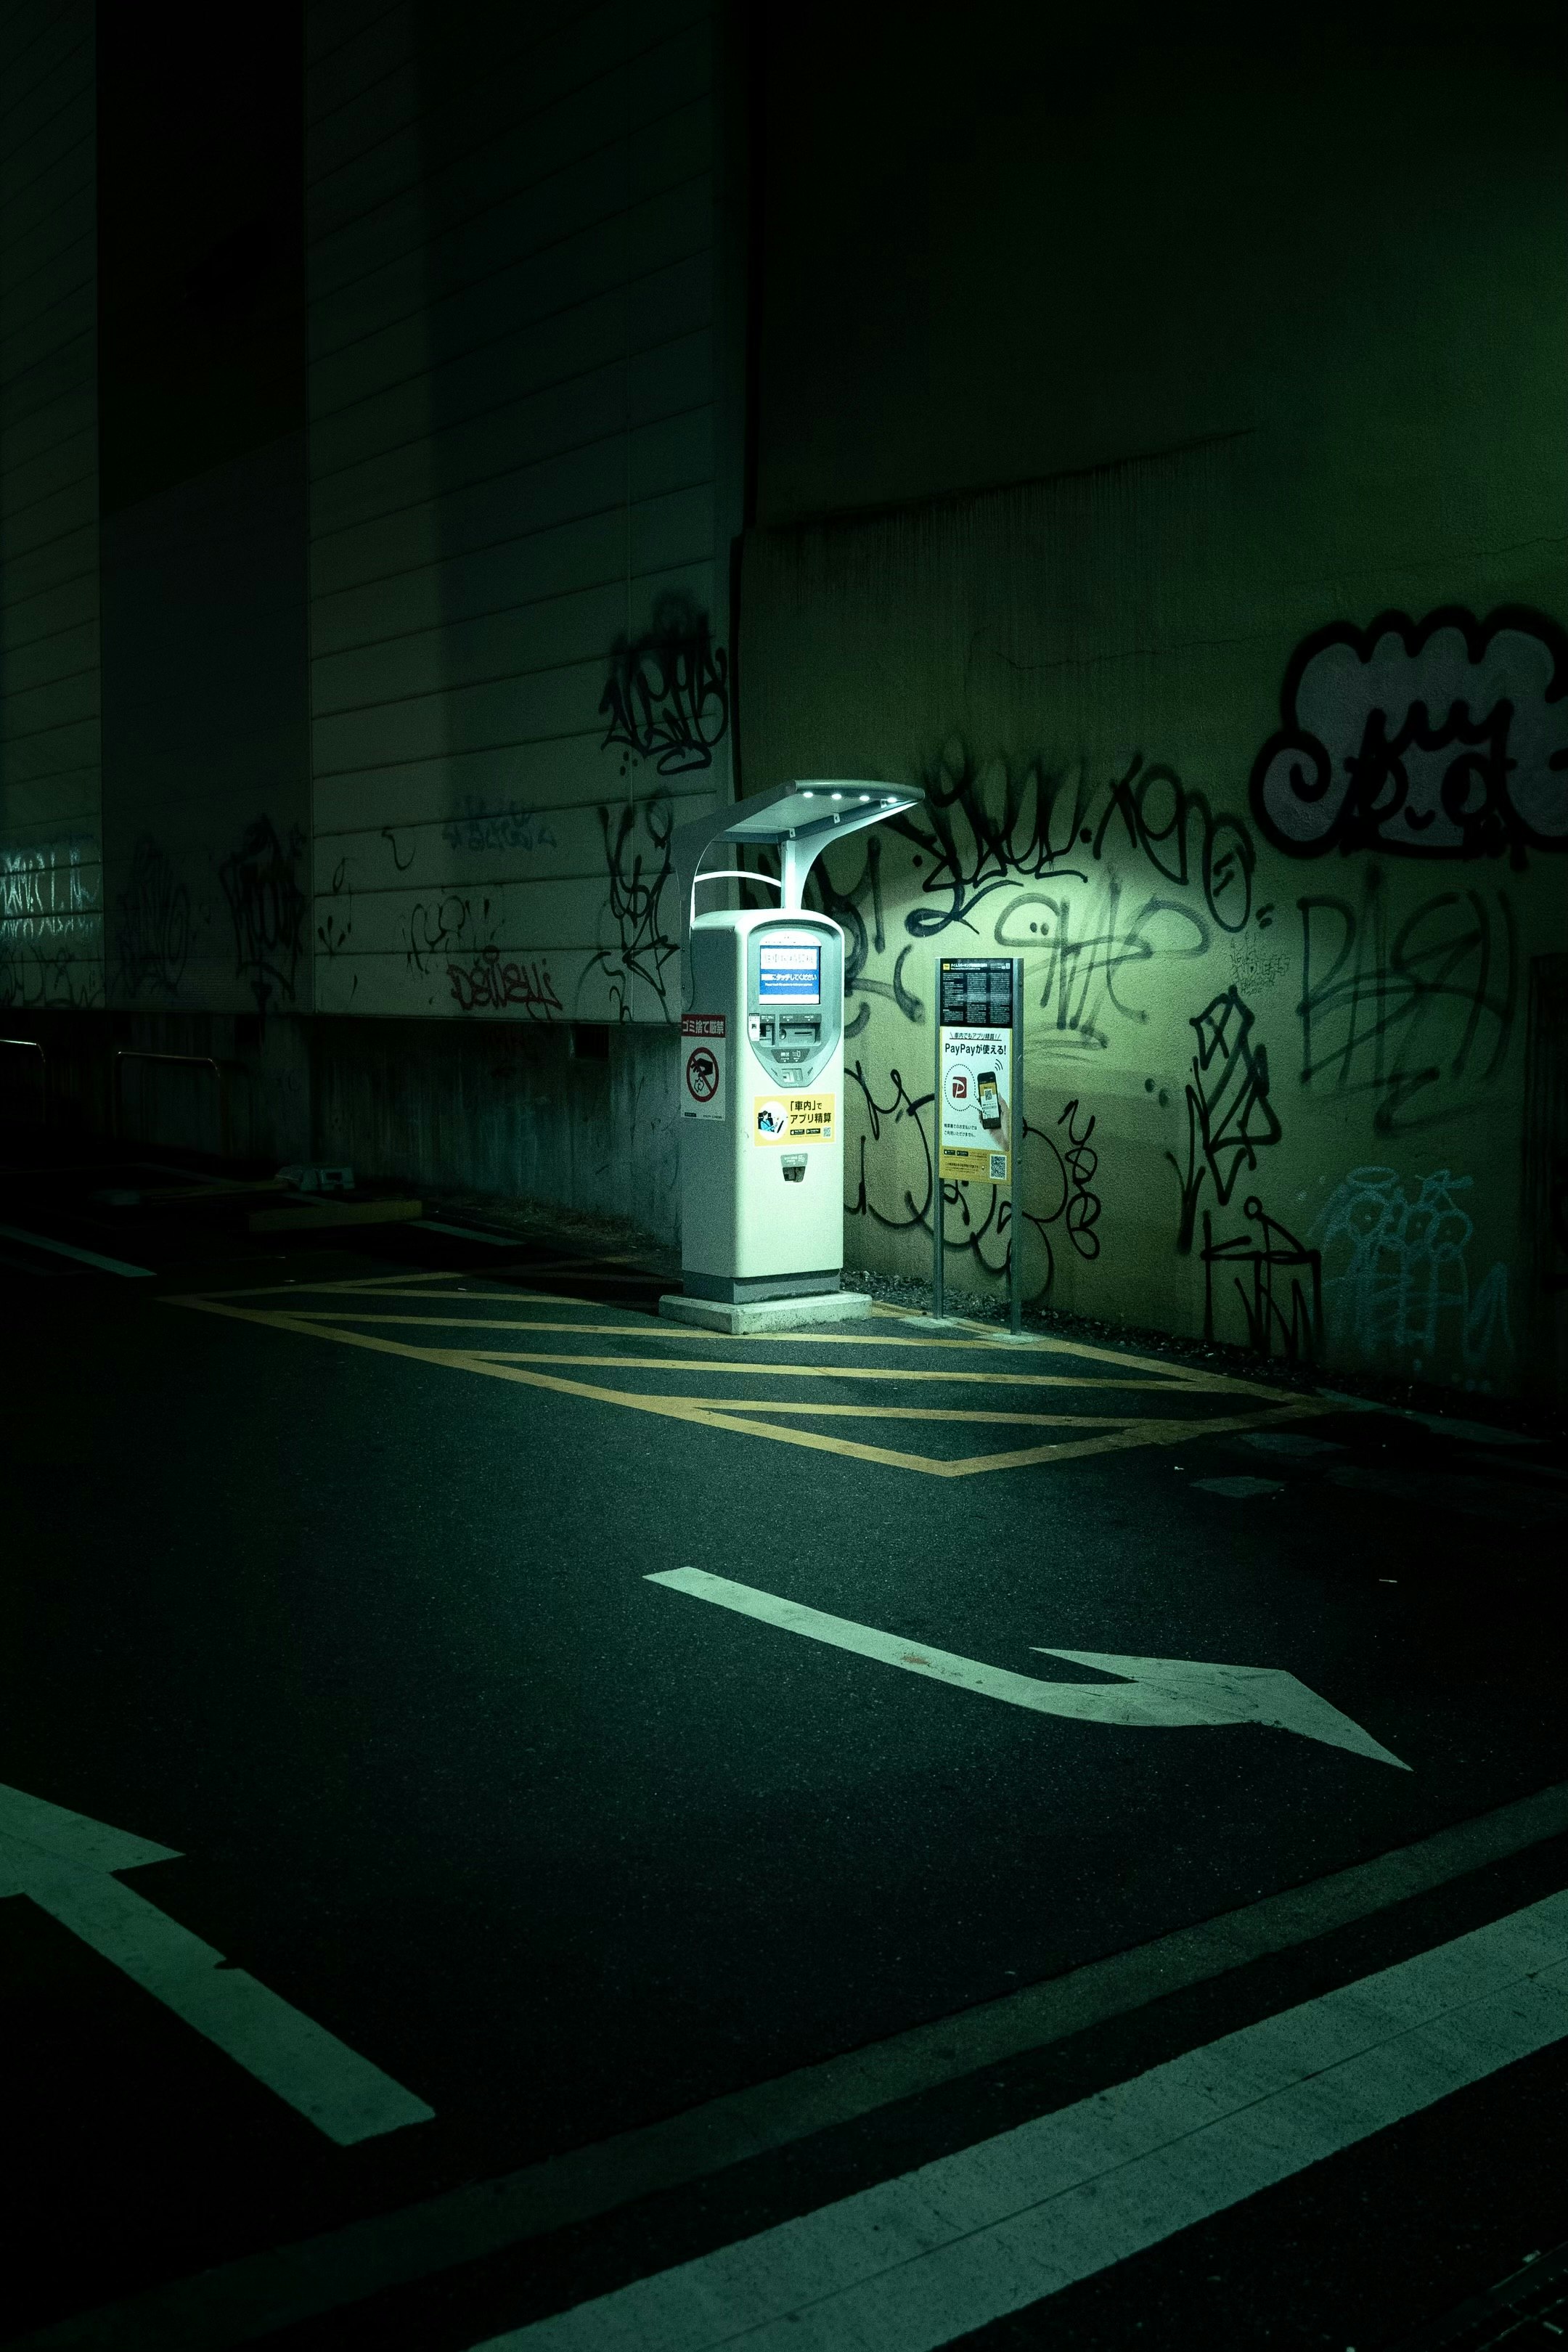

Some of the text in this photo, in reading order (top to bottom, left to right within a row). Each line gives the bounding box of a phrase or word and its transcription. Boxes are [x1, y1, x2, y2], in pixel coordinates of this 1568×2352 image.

[682, 1019, 724, 1034] ゴミ捨て厳禁
[944, 1042, 1007, 1057] PayPayが使える!
[790, 1100, 822, 1111] 「車内」で
[790, 1112, 832, 1124] アプリ精算
